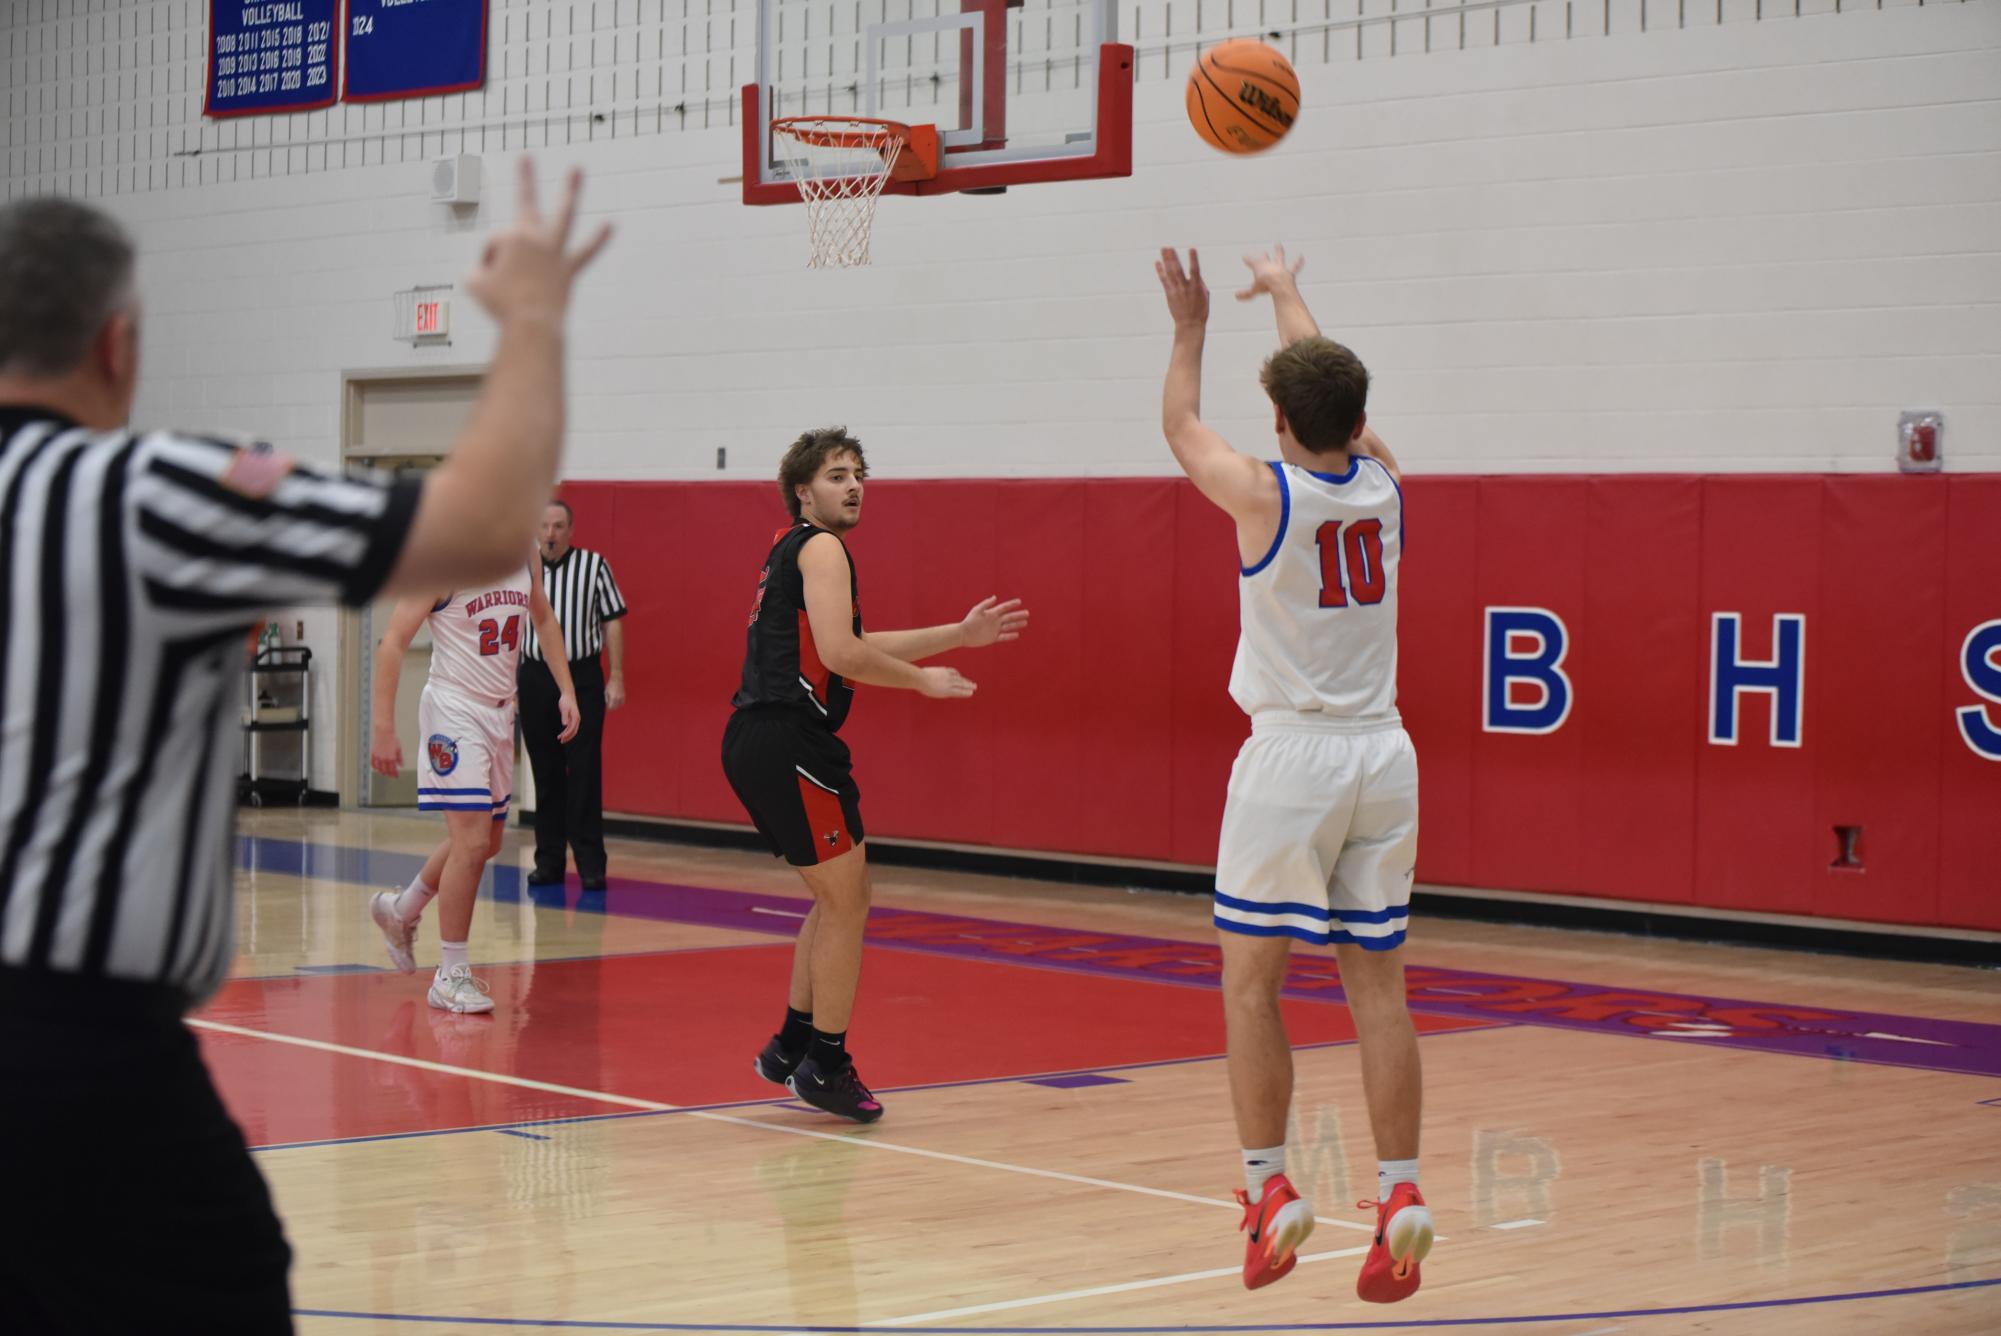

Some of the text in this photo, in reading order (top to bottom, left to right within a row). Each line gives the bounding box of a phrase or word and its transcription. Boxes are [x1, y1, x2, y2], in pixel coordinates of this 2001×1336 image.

[242, 2, 304, 26] VOLLEYBALL
[216, 21, 330, 54] 2008 2011 2015 2018 2021
[218, 56, 236, 76] 2009
[238, 53, 258, 73] 2013
[282, 48, 301, 68] 2019
[307, 43, 327, 64] 2022
[217, 64, 327, 98] 2010 2014 2017 2020 2023
[416, 303, 438, 333] EXIT
[1315, 518, 1385, 608] 10
[465, 590, 529, 618] WARRIORS
[479, 615, 520, 656] 24
